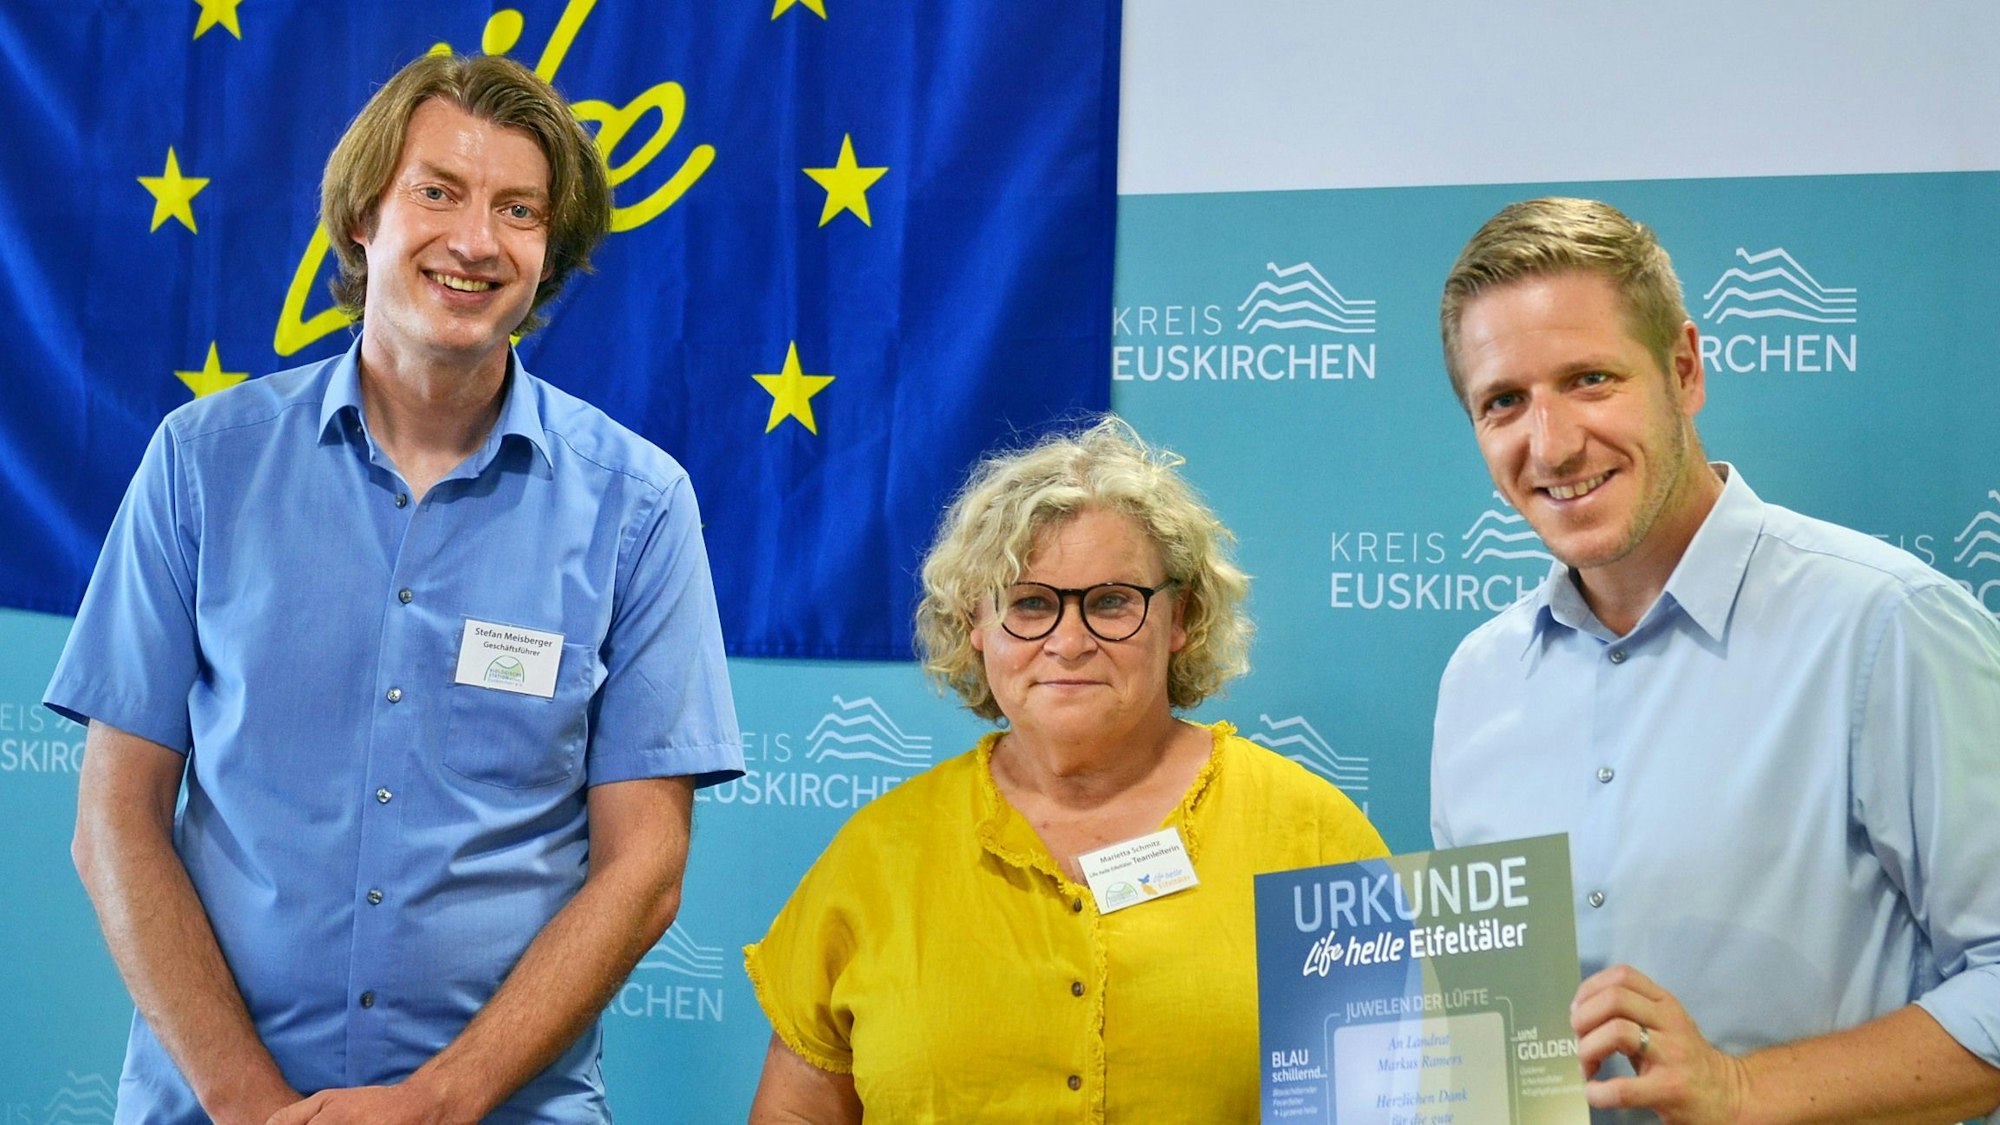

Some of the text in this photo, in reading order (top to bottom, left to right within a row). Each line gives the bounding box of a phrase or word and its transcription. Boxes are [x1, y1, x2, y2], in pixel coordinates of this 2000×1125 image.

[1113, 304, 1222, 336] KREIS
[1112, 343, 1376, 381] EUSKIRCHEN
[1331, 532, 1445, 564] KREIS
[475, 627, 553, 648] Stefan Meisberger
[483, 641, 541, 657] Geschäftsführer
[1100, 840, 1161, 864] Marietta Schmitz
[1132, 845, 1180, 864] Teamleiterin
[1293, 856, 1529, 932] URKUNDE
[1302, 918, 1528, 977] Life helle Eifeltäler
[1345, 988, 1489, 1023] JUWELEN DER LÜFTE
[1388, 1034, 1450, 1051] An Landrat
[1271, 1048, 1309, 1068] BLAU
[1377, 1055, 1463, 1072] Markus Ramers
[1376, 1088, 1468, 1108] Herzlichen Dank
